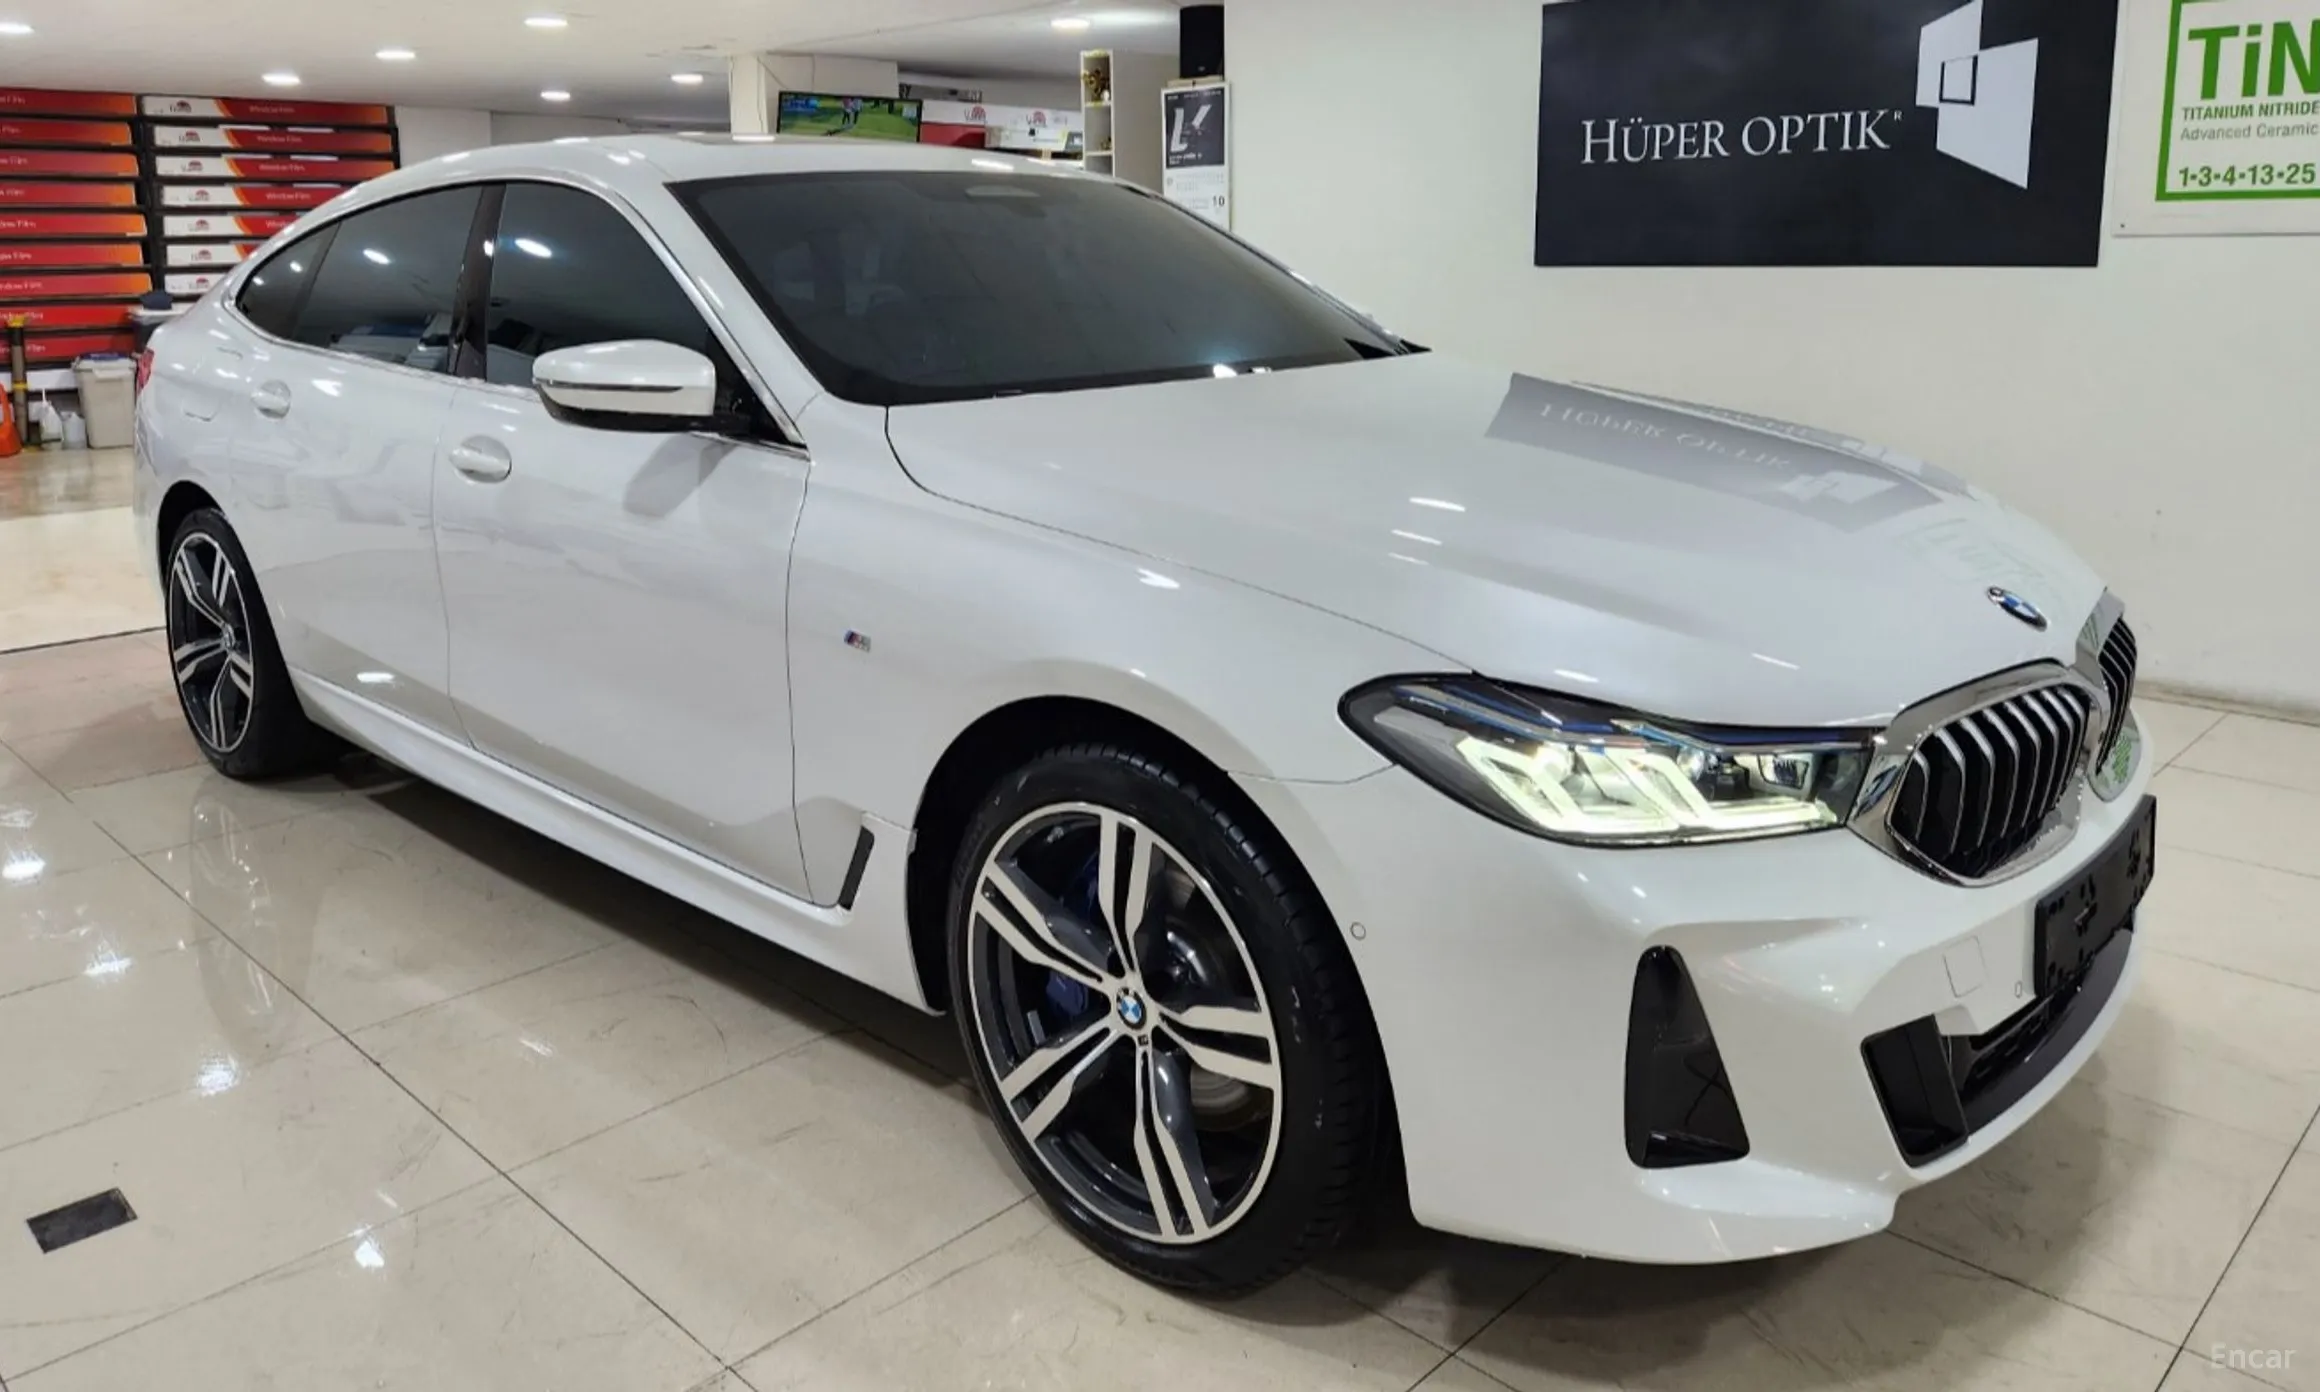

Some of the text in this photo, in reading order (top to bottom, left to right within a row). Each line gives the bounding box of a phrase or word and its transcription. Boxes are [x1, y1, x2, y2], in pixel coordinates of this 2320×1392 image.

[2188, 19, 2320, 100] TiN
[2181, 101, 2320, 121] TITANIUM NITRIDE
[1580, 117, 1730, 164] HÜPER
[2180, 122, 2319, 141] Advanced Ceramic
